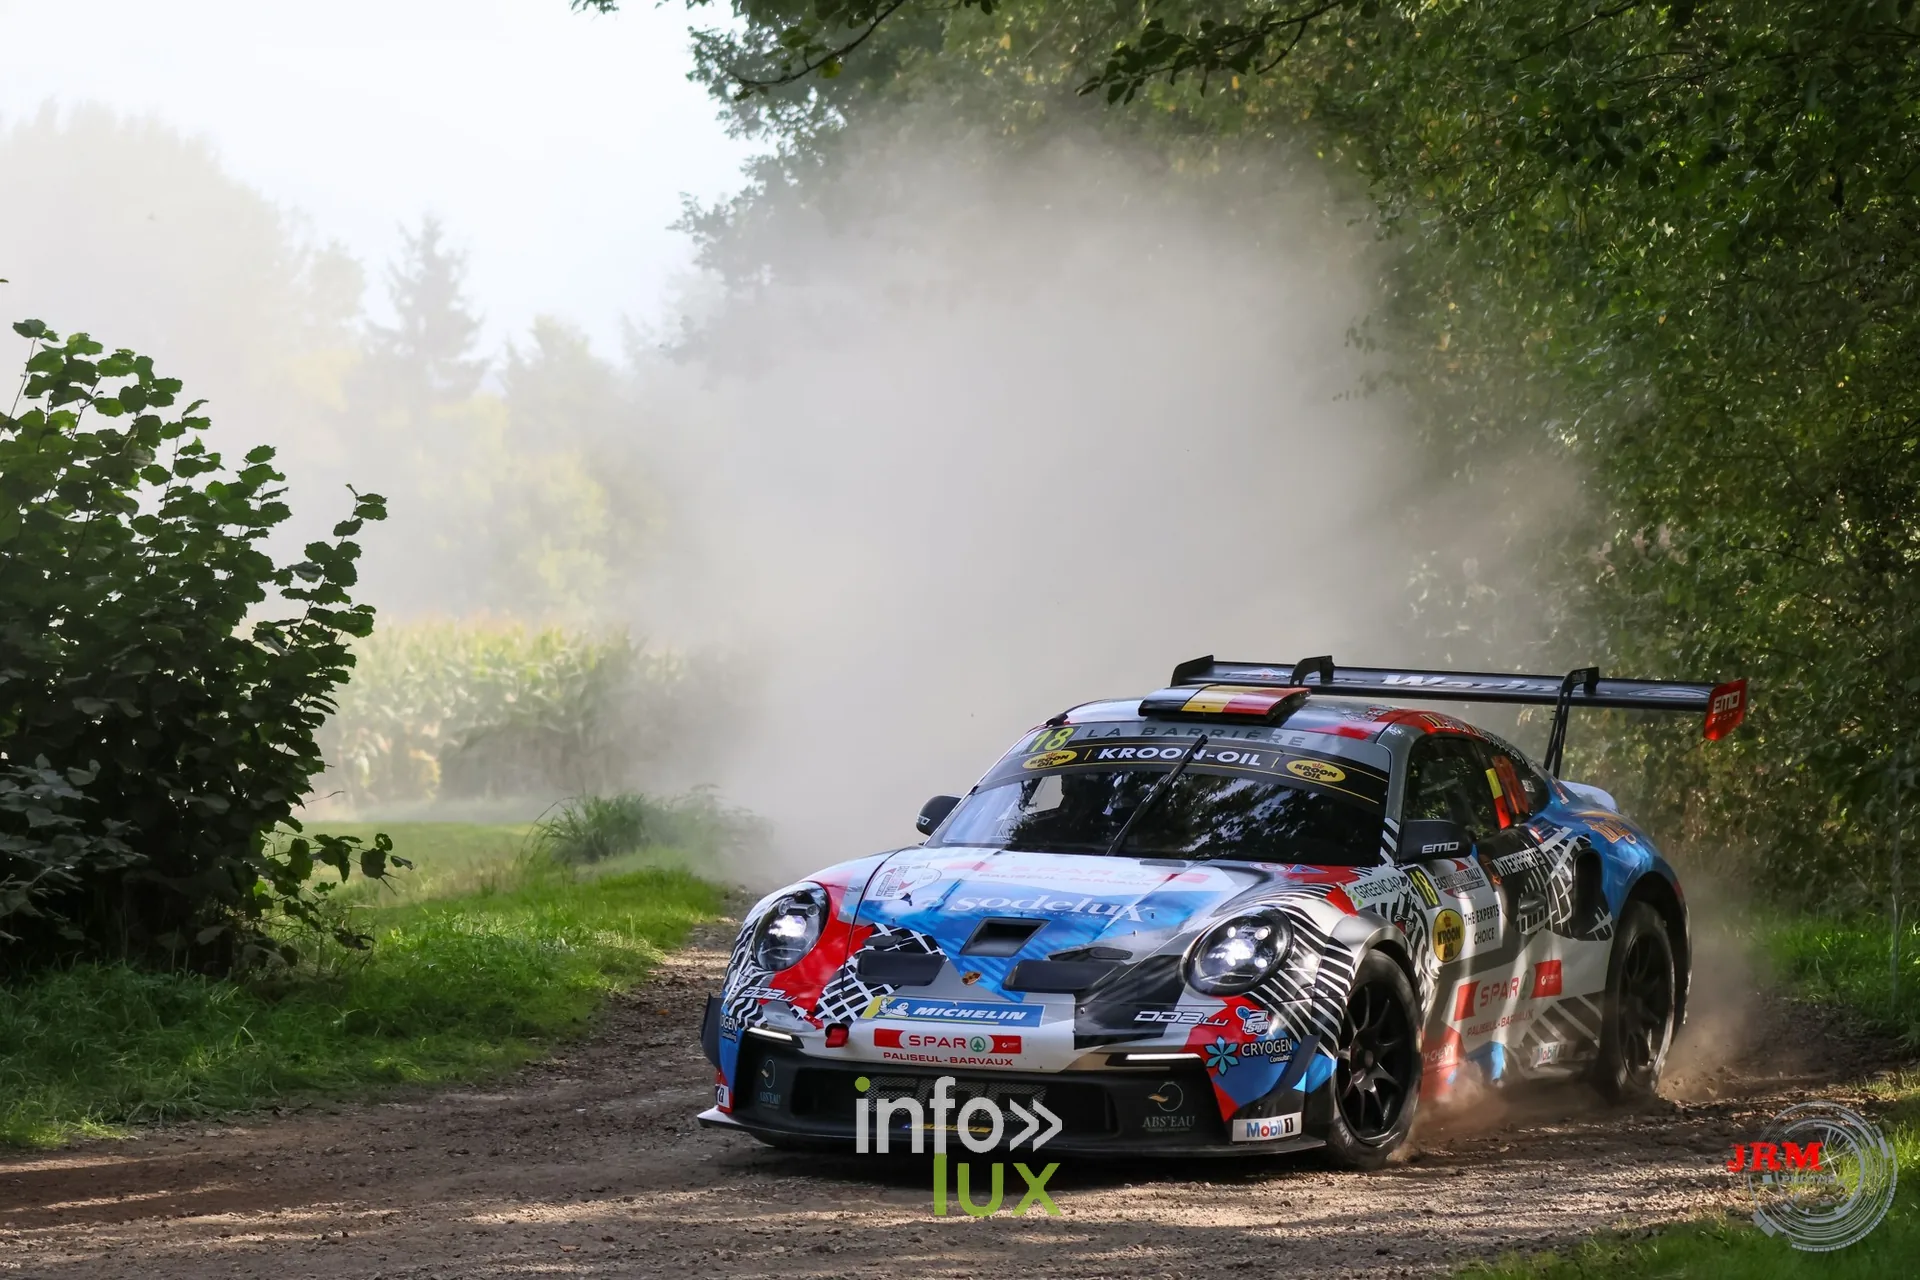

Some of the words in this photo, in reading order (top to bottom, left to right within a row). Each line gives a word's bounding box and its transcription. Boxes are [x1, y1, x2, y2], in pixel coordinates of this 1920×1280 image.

[1030, 727, 1074, 753] 18
[1086, 727, 1121, 738] LA
[1031, 754, 1070, 765] KROON
[1098, 747, 1261, 766] KROON-OIL
[1294, 763, 1338, 778] KROON
[1302, 771, 1321, 780] OIL
[1422, 842, 1459, 854] EMO
[1491, 847, 1546, 877] INTERPARTS
[1410, 870, 1437, 906] 18
[950, 895, 1158, 927] sodelux
[1464, 911, 1475, 926] THE
[1476, 904, 1499, 921] EXPERTS
[1437, 927, 1461, 945] KROON
[1474, 927, 1494, 945] CHOICE
[1480, 977, 1520, 1008] SPAR
[913, 1007, 1027, 1020] MICHELIN
[908, 1034, 967, 1049] SPAR
[1241, 1038, 1293, 1056] CRYOGEN
[1246, 1120, 1283, 1138] Mobil
[1285, 1117, 1294, 1133] 1
